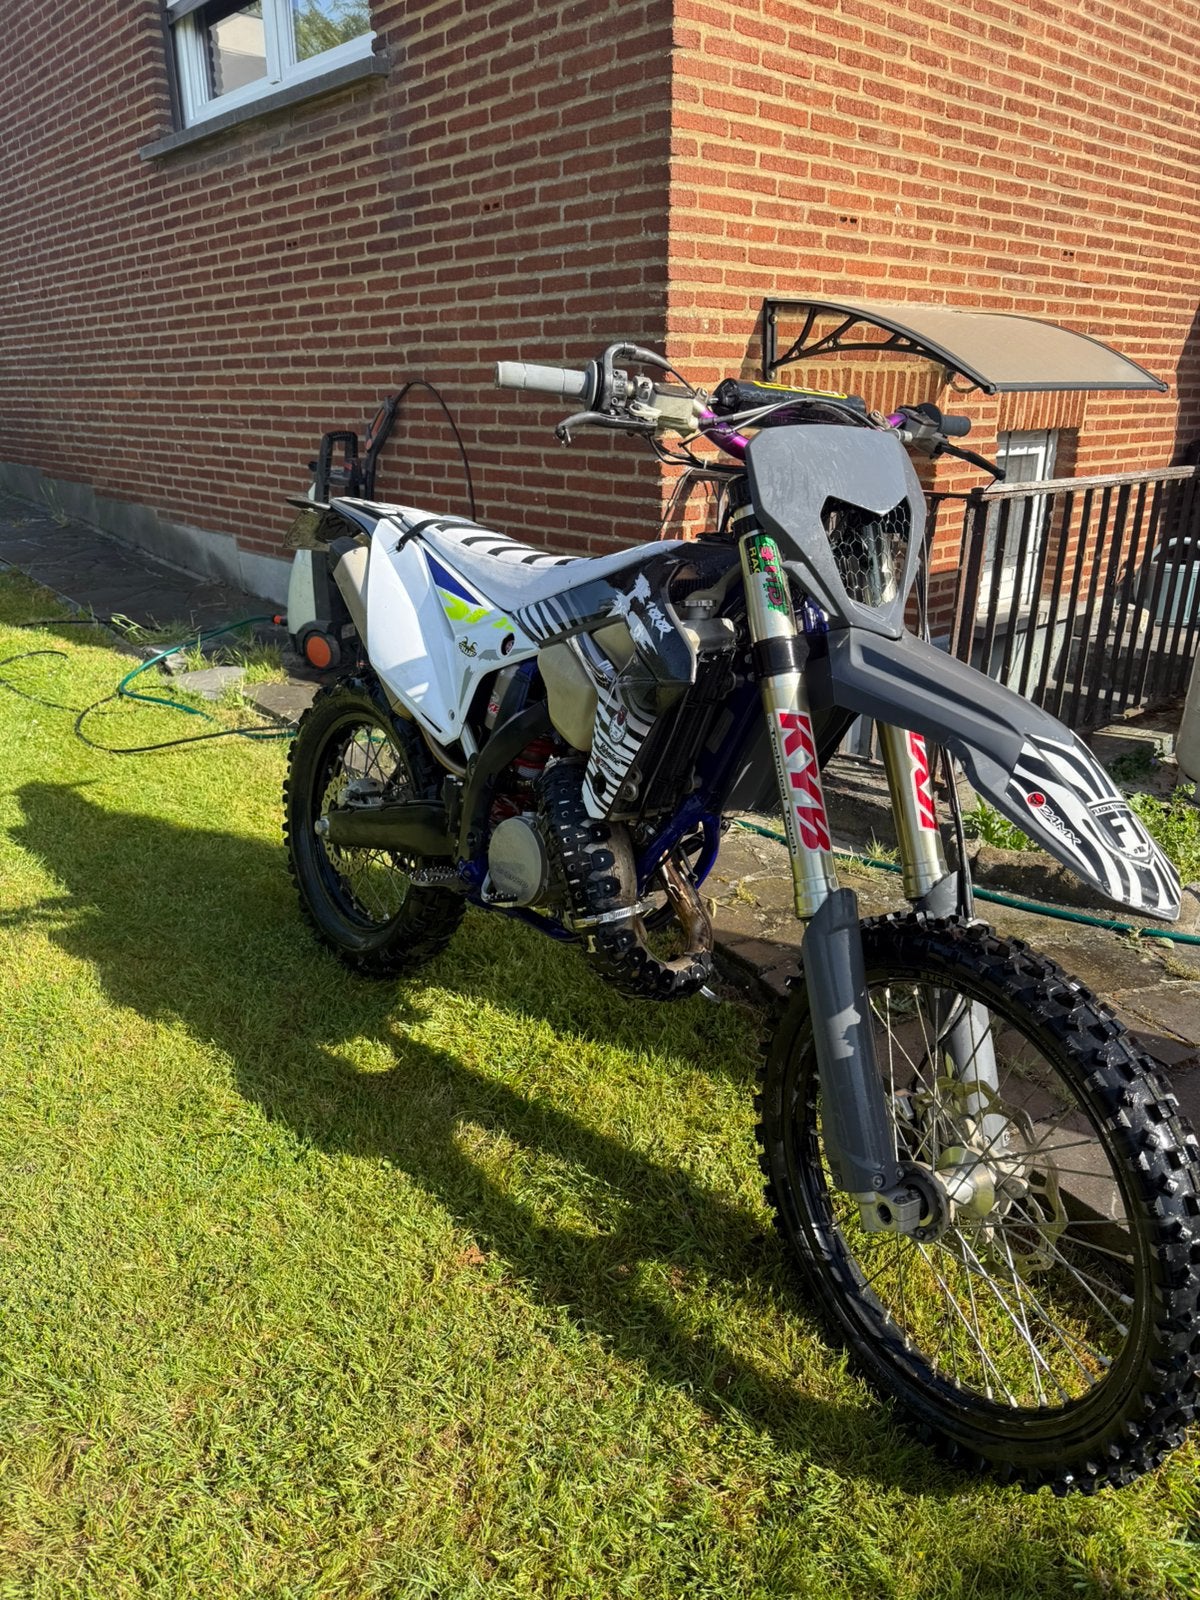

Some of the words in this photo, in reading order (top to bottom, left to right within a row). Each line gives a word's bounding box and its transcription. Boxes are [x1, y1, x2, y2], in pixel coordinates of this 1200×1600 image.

[770, 727, 788, 801] Technical
[785, 807, 798, 855] Touch
[779, 713, 831, 852] KYB
[919, 971, 959, 990] EXCEL
